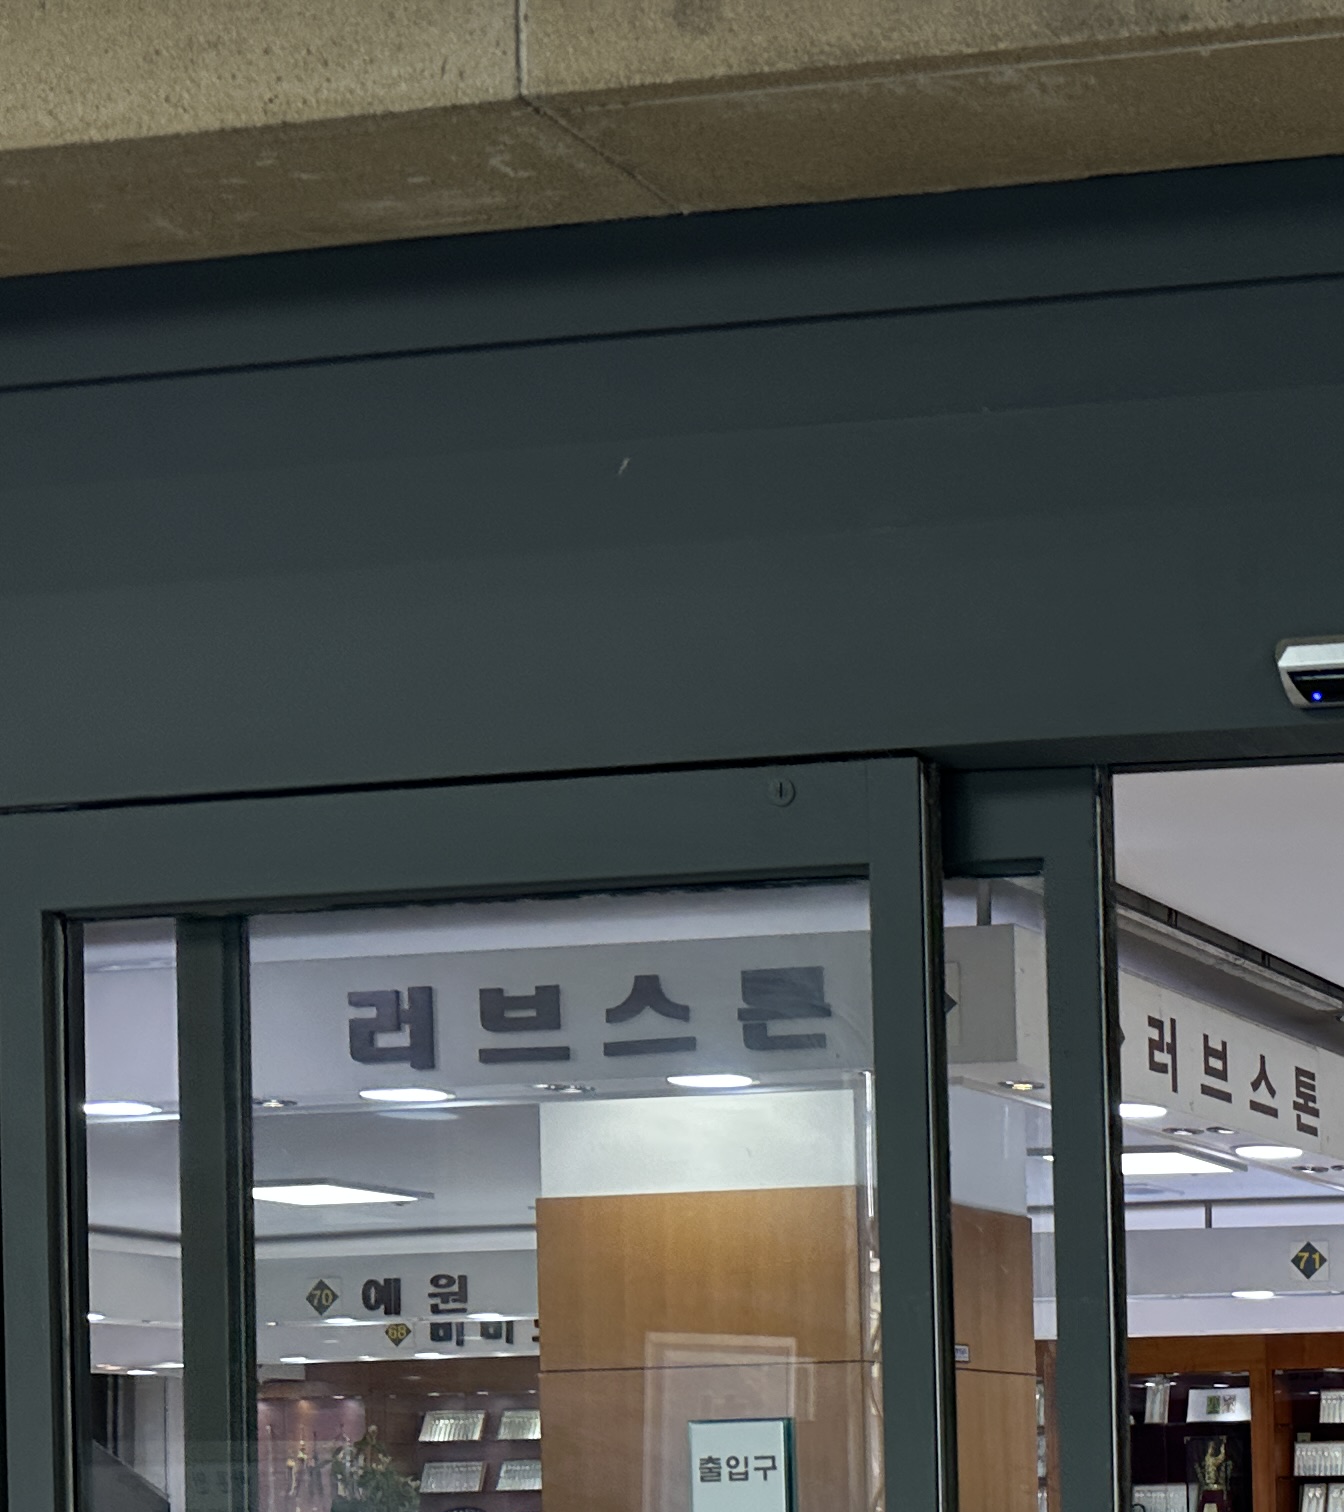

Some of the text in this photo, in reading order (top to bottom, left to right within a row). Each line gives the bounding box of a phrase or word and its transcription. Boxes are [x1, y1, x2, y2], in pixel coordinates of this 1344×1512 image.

[347, 966, 832, 1070] 러브스톤
[1147, 1014, 1320, 1137] 러브스톤
[1298, 1251, 1321, 1271] 71
[311, 1274, 468, 1316] 70 예원
[388, 1323, 407, 1340] 68
[699, 1455, 778, 1482] 출입구
